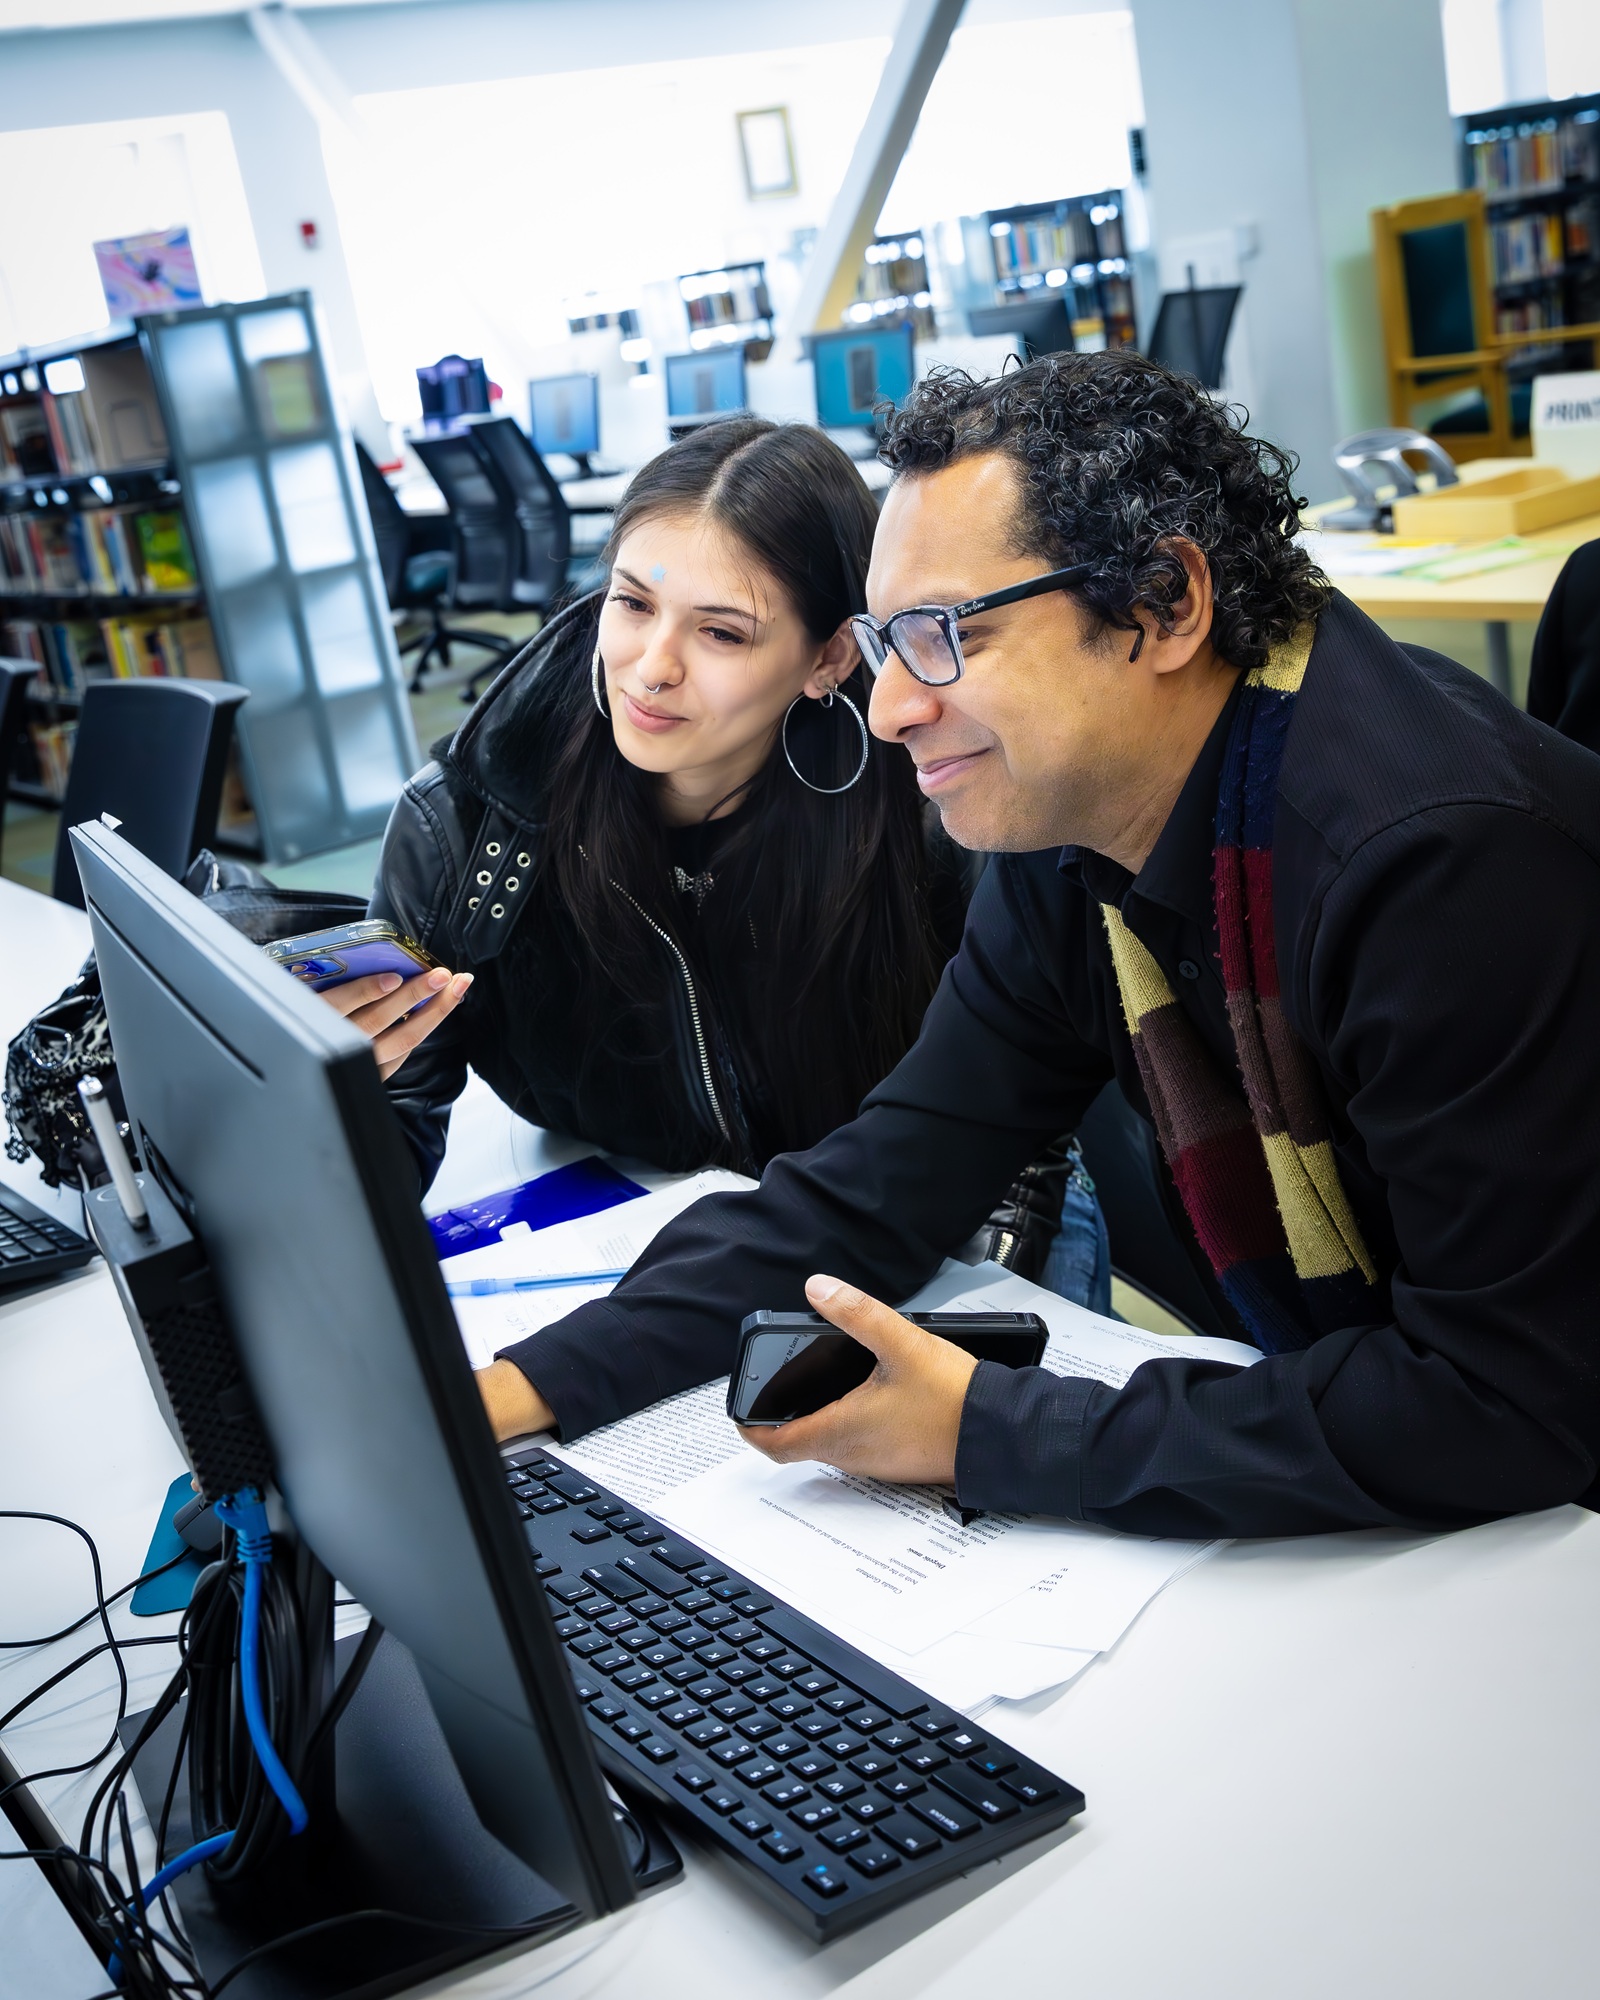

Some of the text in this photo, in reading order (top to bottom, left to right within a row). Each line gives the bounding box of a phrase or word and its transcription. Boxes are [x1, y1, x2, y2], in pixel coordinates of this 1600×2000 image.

[838, 1479, 852, 1488] from
[857, 1480, 873, 1489] agree
[866, 1492, 898, 1511] (apparently)
[881, 1491, 901, 1504] viewers
[900, 1502, 916, 1511] most
[915, 1499, 932, 1509] music
[771, 1504, 799, 1520] interpretive
[897, 1509, 910, 1518] that
[914, 1508, 931, 1519] While
[929, 1505, 943, 1515] film
[798, 1518, 816, 1530] various
[910, 1515, 927, 1526] music
[933, 1517, 959, 1532] narrative.
[819, 1531, 832, 1539] and
[967, 1524, 997, 1540] particular
[830, 1536, 842, 1545] film
[945, 1533, 970, 1548] Diegetic
[968, 1534, 987, 1545] within
[657, 1546, 668, 1554] Ctrl
[927, 1538, 957, 1555] Definitions
[851, 1548, 864, 1557] flow
[623, 1556, 636, 1566] Shift
[861, 1554, 890, 1570] diachronic
[906, 1547, 946, 1570] Diegetic music
[588, 1568, 602, 1578] Enter
[888, 1567, 899, 1575] the
[855, 1567, 903, 1594] Claudia Gorbman
[904, 1575, 919, 1585] both
[686, 1635, 697, 1643] L
[755, 1646, 770, 1655] M
[653, 1653, 665, 1661] O
[780, 1663, 794, 1671] N
[807, 1681, 819, 1689] B
[699, 1687, 712, 1695] U
[755, 1686, 770, 1694] H
[723, 1706, 736, 1714] Y
[782, 1704, 794, 1712] G
[860, 1717, 873, 1725] C
[712, 1725, 723, 1733] 6
[926, 1722, 938, 1730] Alt
[887, 1736, 902, 1745] X
[653, 1746, 664, 1755] F5
[737, 1744, 749, 1752] 5
[776, 1743, 789, 1752] R
[836, 1742, 849, 1751] D
[916, 1756, 931, 1765] Z
[803, 1763, 817, 1772] E
[864, 1762, 878, 1770] S
[791, 1785, 804, 1793] 3
[827, 1782, 844, 1792] W
[894, 1782, 908, 1790] A
[1022, 1786, 1037, 1796] Ctrl
[820, 1806, 833, 1814] 2
[860, 1804, 874, 1813] Q
[982, 1800, 999, 1812] Shift
[746, 1820, 758, 1829] F2
